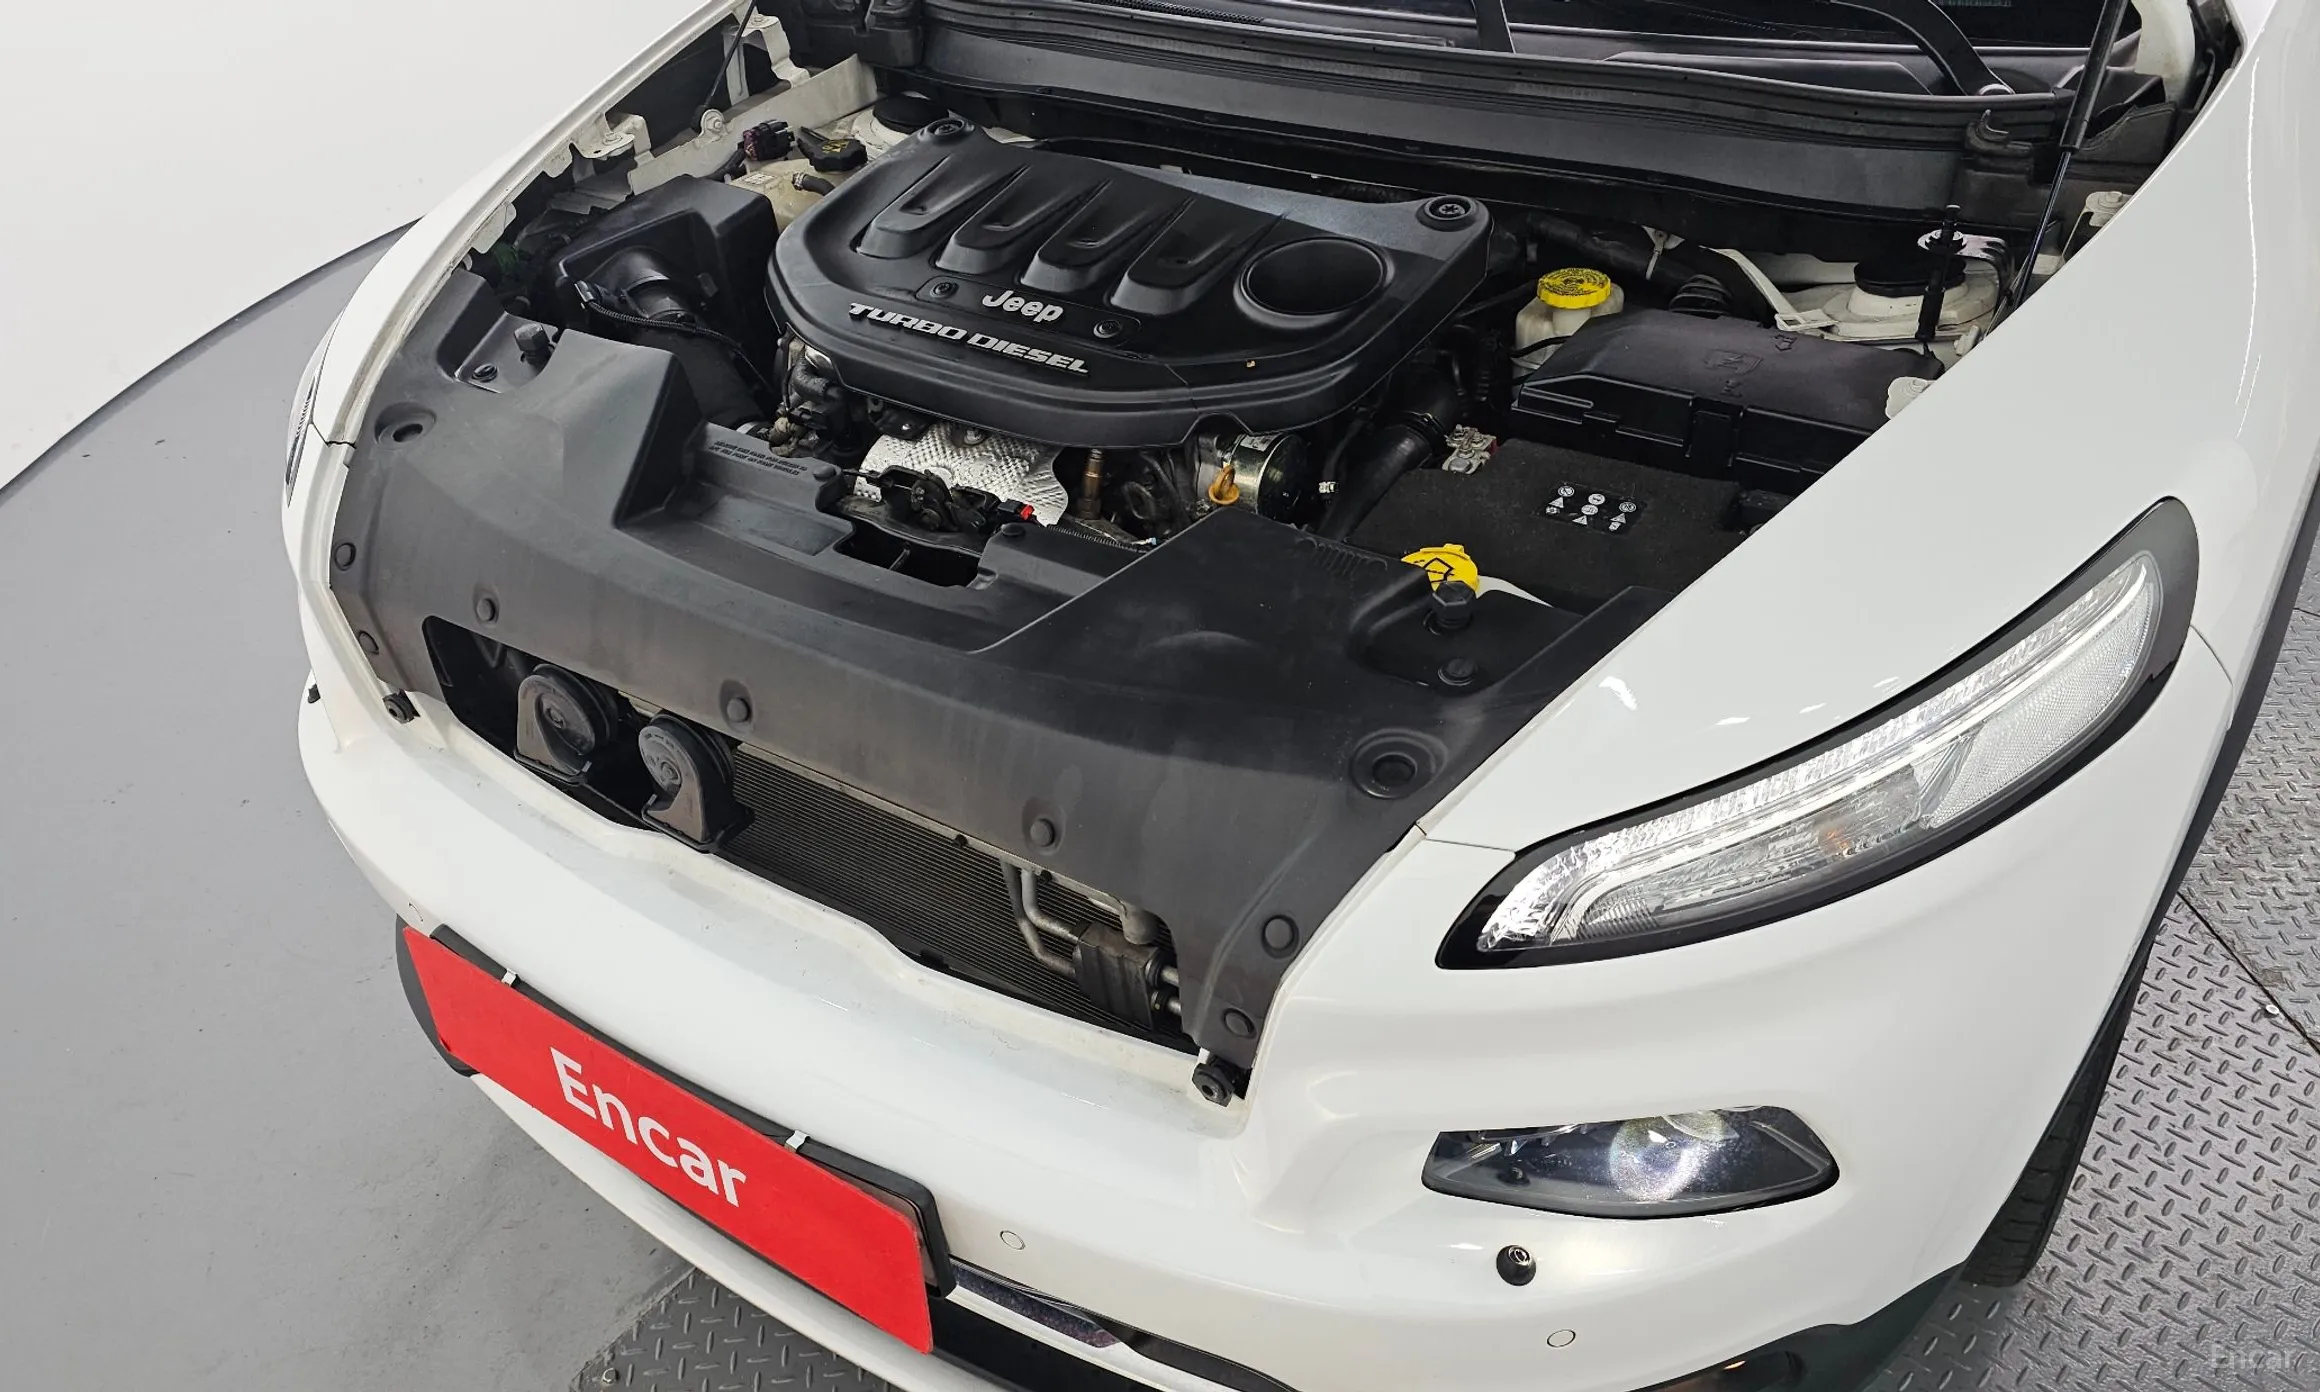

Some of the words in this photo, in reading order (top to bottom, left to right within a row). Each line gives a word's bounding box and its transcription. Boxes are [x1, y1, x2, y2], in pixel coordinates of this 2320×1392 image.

[850, 302, 969, 341] TURBO
[966, 333, 1089, 374] DIESEL
[981, 290, 1064, 323] Jeep
[549, 1046, 747, 1208] Encar
